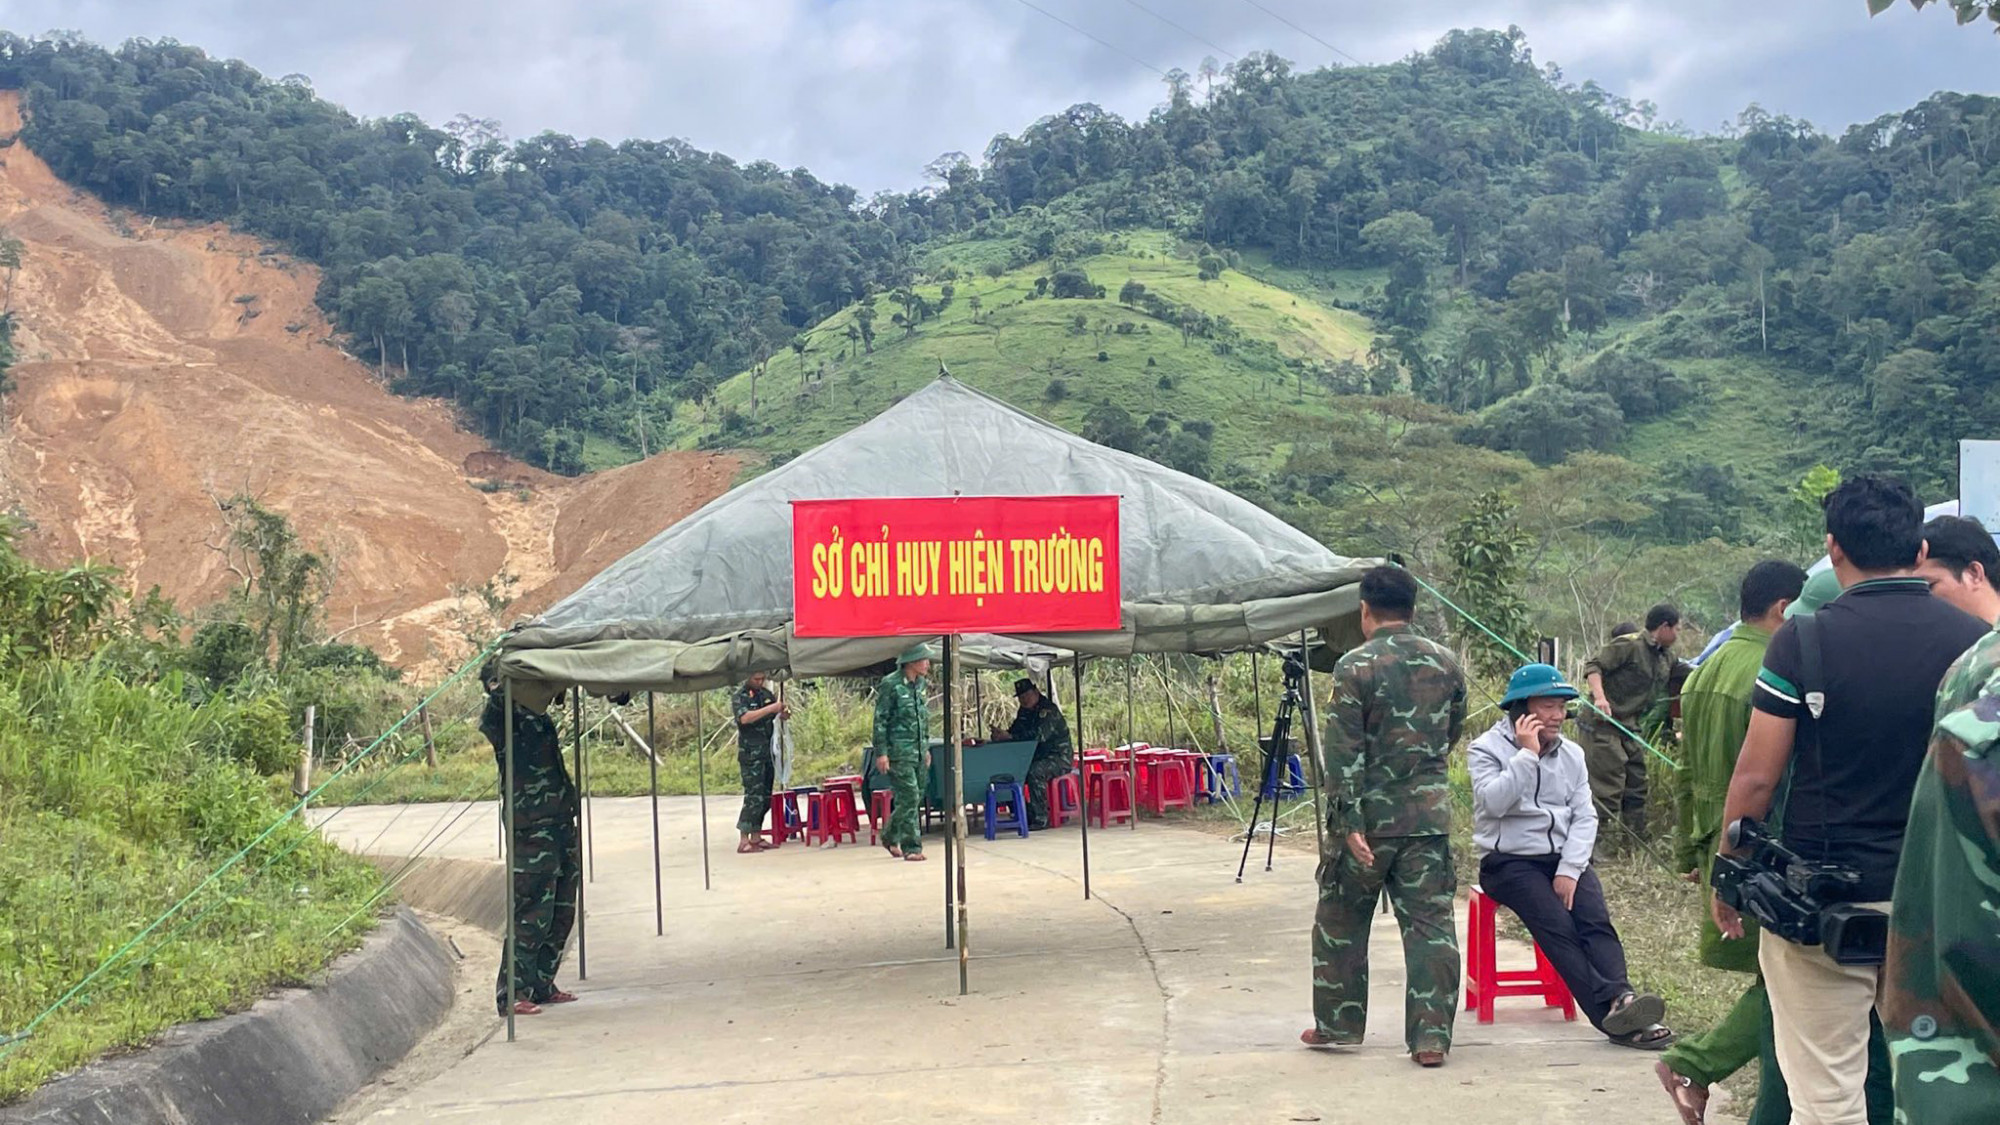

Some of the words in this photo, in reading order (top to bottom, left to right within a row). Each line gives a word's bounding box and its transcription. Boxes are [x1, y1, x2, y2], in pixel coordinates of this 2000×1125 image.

[812, 525, 844, 598] SỞ
[850, 524, 889, 597] CHỈ
[896, 541, 942, 597] HUY
[948, 529, 1004, 607] HIỆN
[1010, 526, 1104, 594] TRƯỜNG
